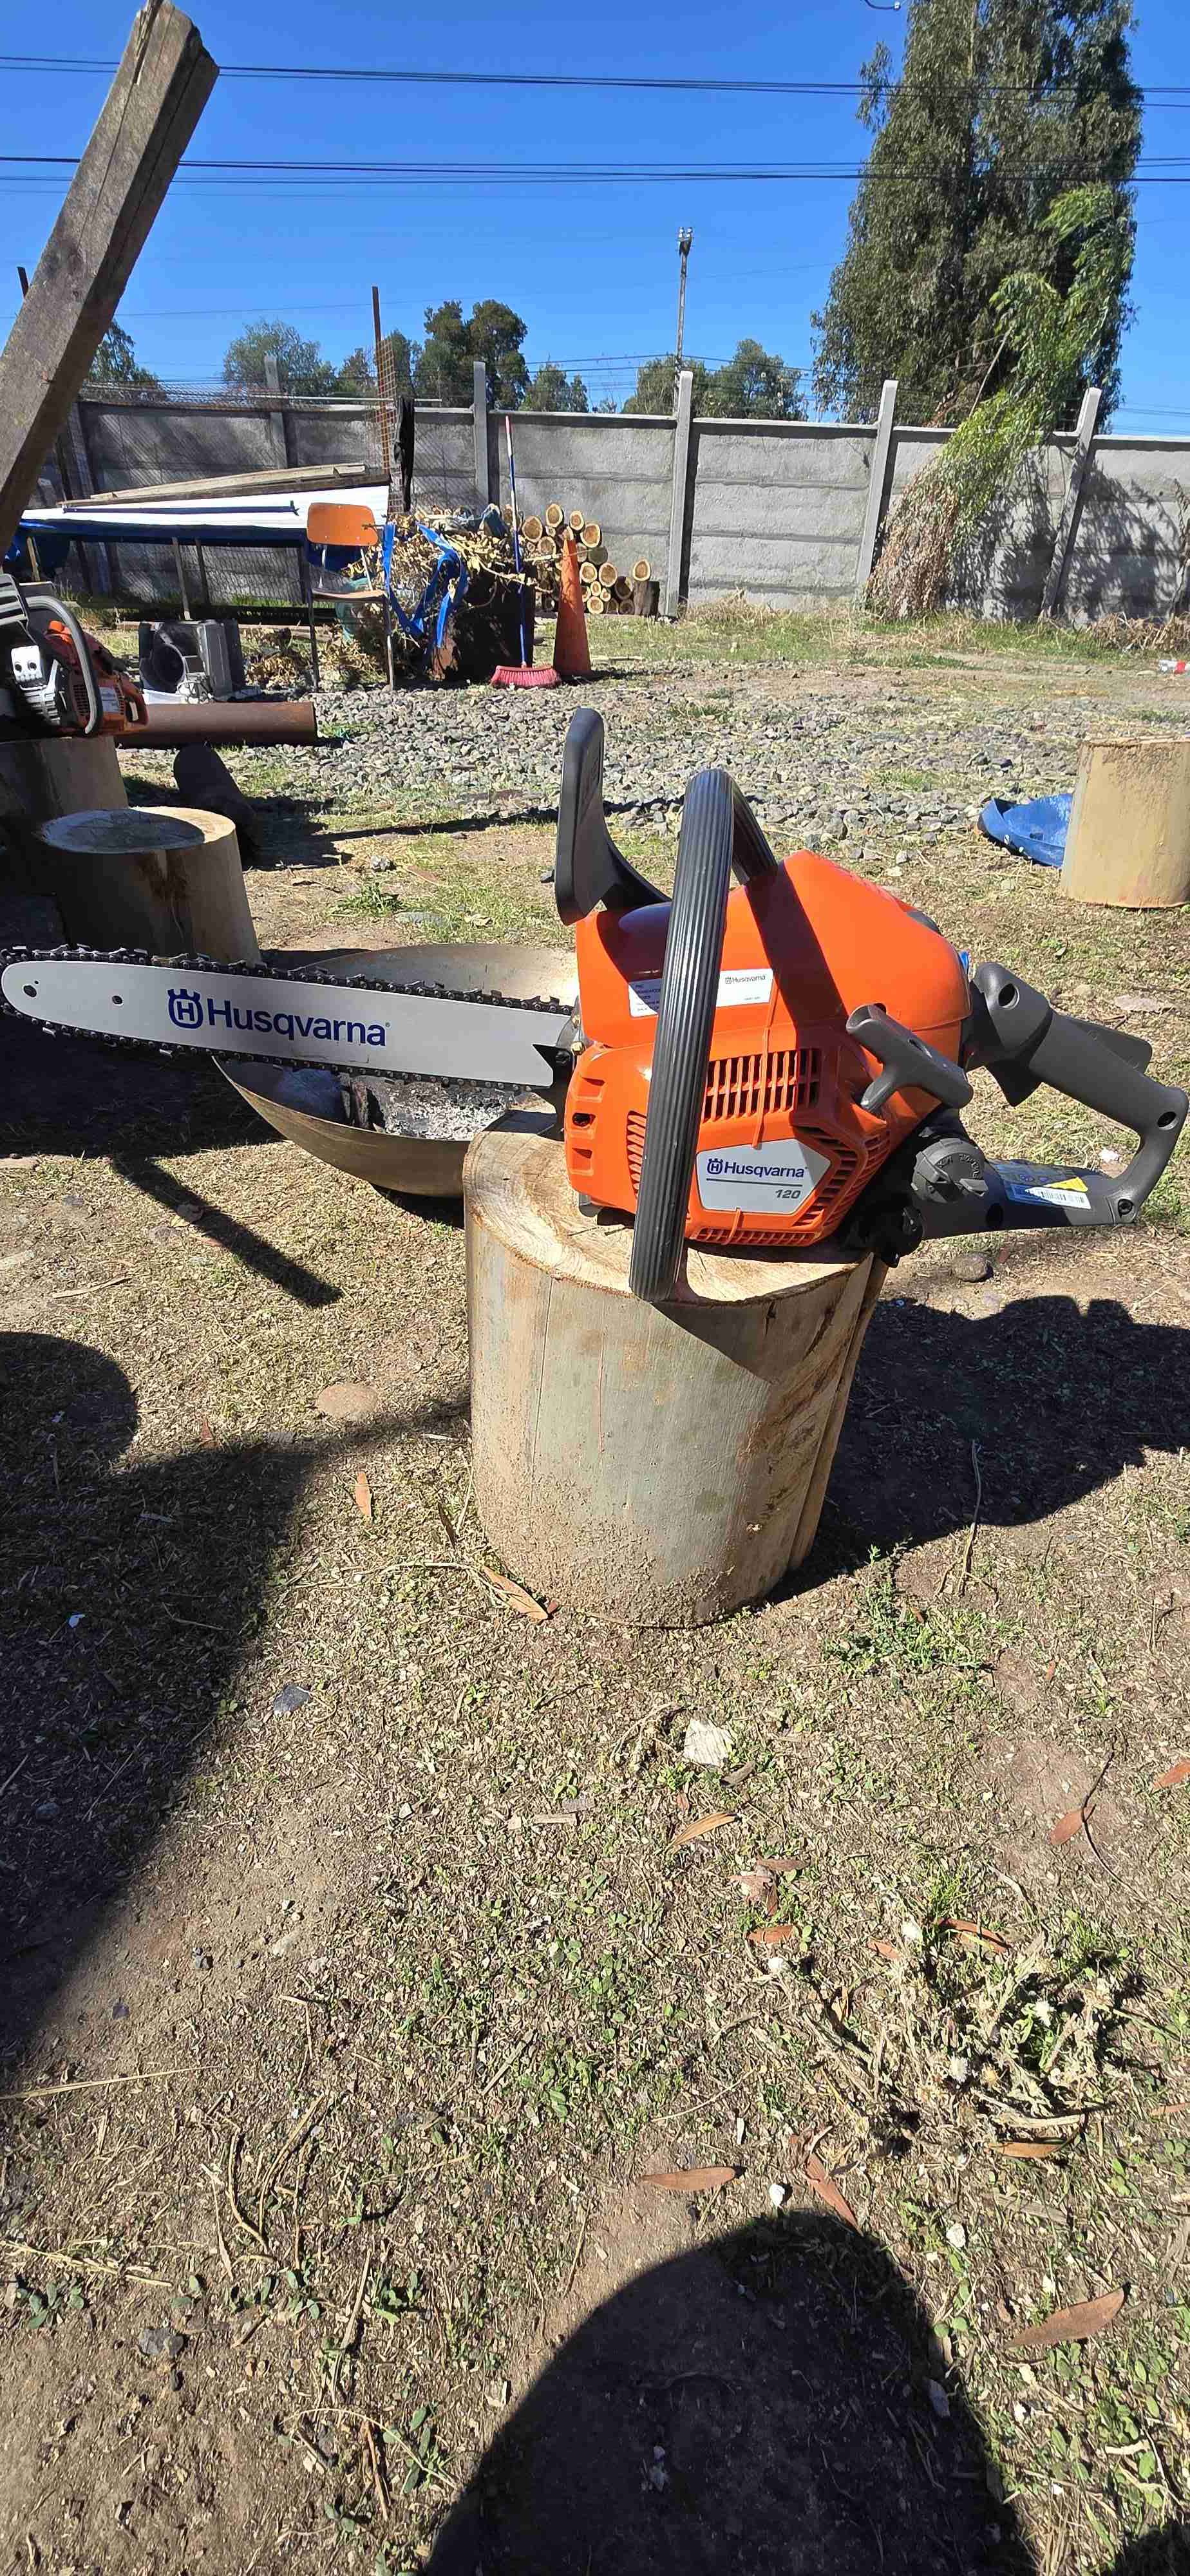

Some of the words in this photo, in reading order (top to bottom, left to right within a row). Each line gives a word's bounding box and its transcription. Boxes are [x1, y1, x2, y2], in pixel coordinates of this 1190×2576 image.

[207, 998, 386, 1046] Husqvarna
[724, 1161, 804, 1178] Husqvarna
[775, 1189, 800, 1199] 120
